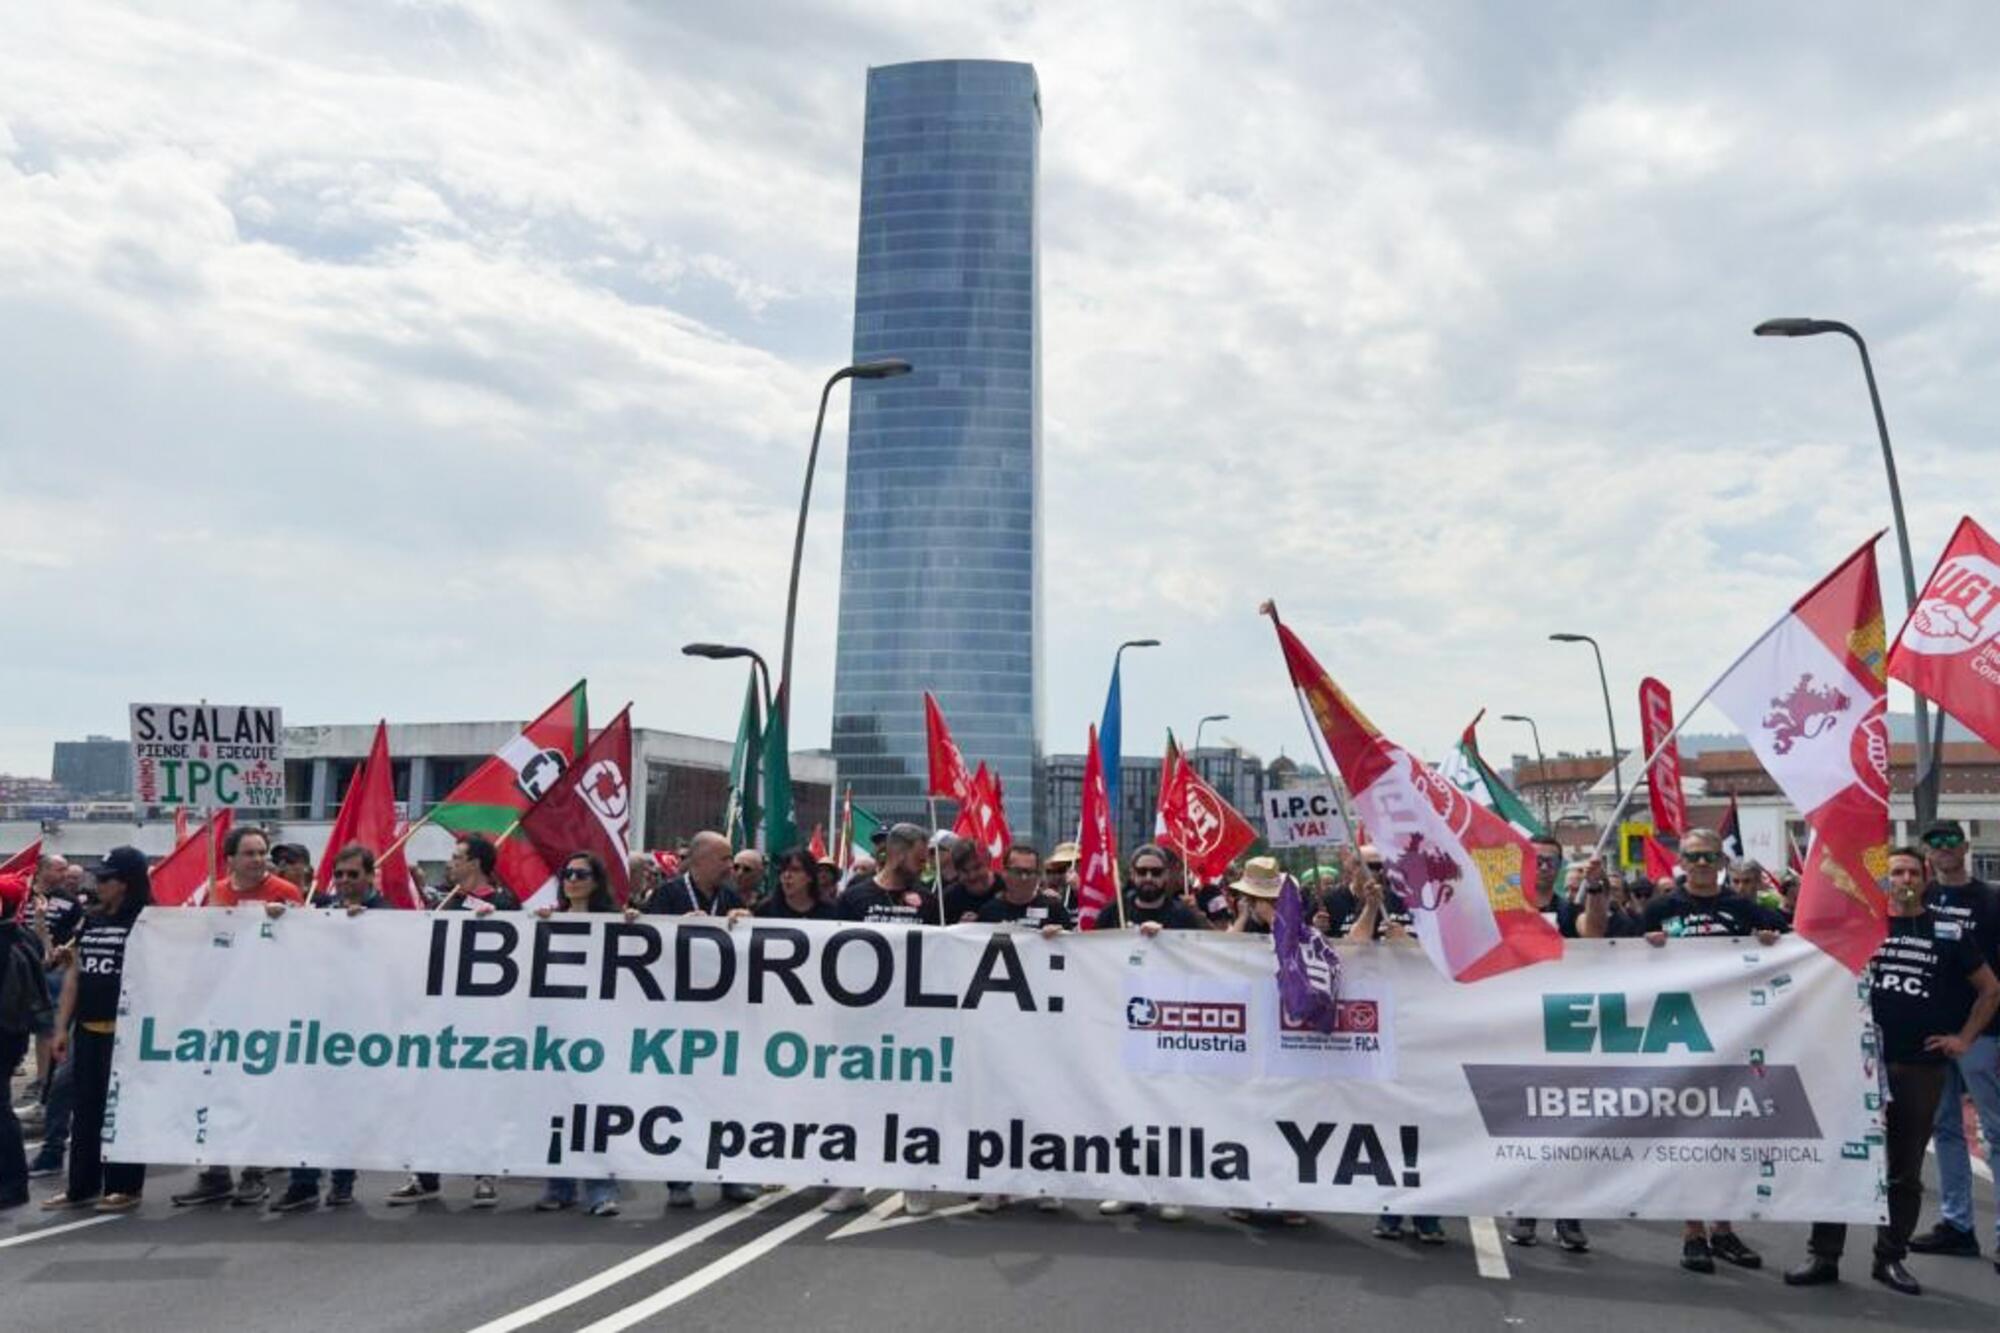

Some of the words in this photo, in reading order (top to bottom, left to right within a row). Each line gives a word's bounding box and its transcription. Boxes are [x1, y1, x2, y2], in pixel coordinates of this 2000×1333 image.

[137, 745, 190, 758] PIENSE
[217, 746, 277, 760] EJECUTE
[160, 760, 240, 803] IPC
[1271, 796, 1338, 818] I.P.C.
[1289, 822, 1326, 840] ¡YA!
[426, 918, 1065, 1013] IBERDROLA:
[1162, 1005, 1240, 1028] CCOO
[1543, 991, 1716, 1053] ELA
[138, 1016, 605, 1076] Langileontzako
[629, 1027, 740, 1077] KPI
[764, 1030, 956, 1084] Orain!
[1157, 1032, 1247, 1053] industria
[1355, 1036, 1379, 1052] FICA
[547, 1103, 684, 1165] ¡IPC
[706, 1120, 857, 1170] para
[884, 1113, 941, 1165] la
[966, 1118, 1250, 1182] plantilla
[1275, 1120, 1422, 1189] YA!
[1496, 1145, 1537, 1161] ATAL
[1542, 1145, 1634, 1162] SINDIKALA
[1656, 1142, 1737, 1163] SECCIÓN
[1740, 1145, 1822, 1163] SINDICAL
